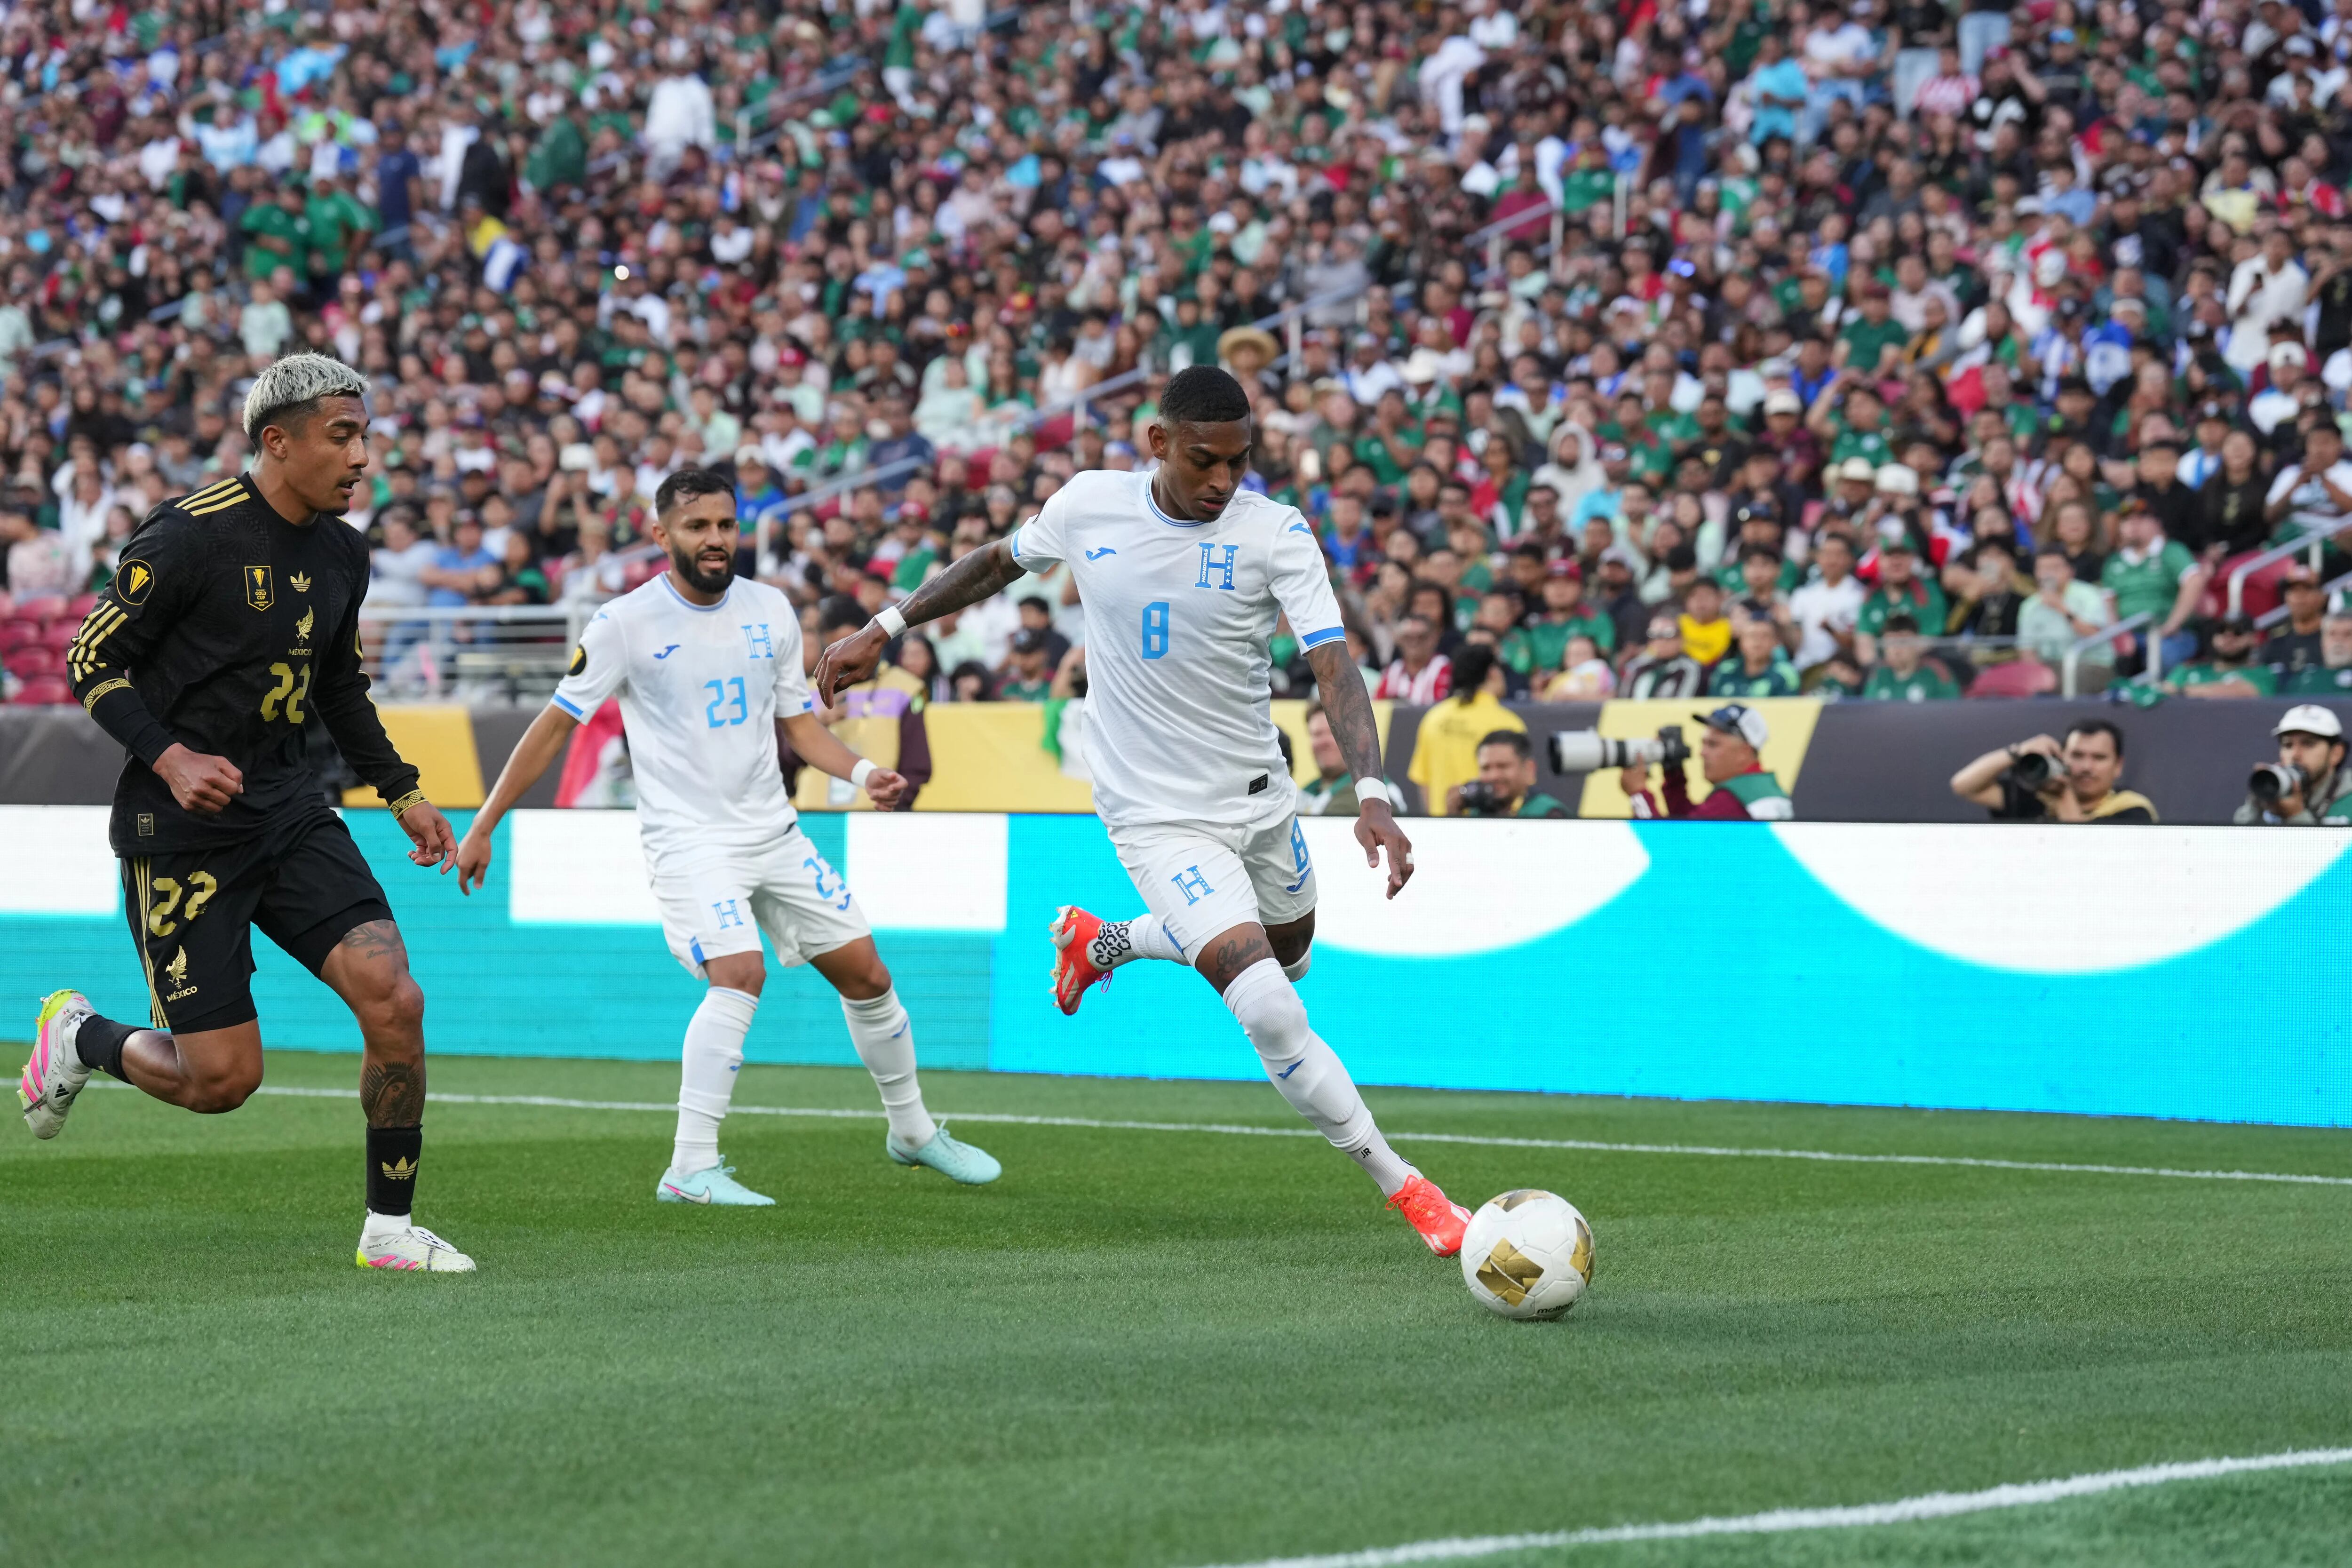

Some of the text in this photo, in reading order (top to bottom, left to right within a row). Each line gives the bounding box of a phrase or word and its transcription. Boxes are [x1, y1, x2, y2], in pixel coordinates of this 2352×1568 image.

[1142, 601, 1169, 660] 8
[287, 647, 312, 656] MÉXICO
[260, 662, 311, 724] 22
[703, 676, 748, 729] 23
[1290, 816, 1309, 874] 8
[149, 870, 217, 937] 22
[1176, 878, 1194, 900] HONDURAS
[166, 986, 198, 1002] MÉXICO
[1360, 1147, 1372, 1158] JR
[1537, 1301, 1573, 1313] molten
